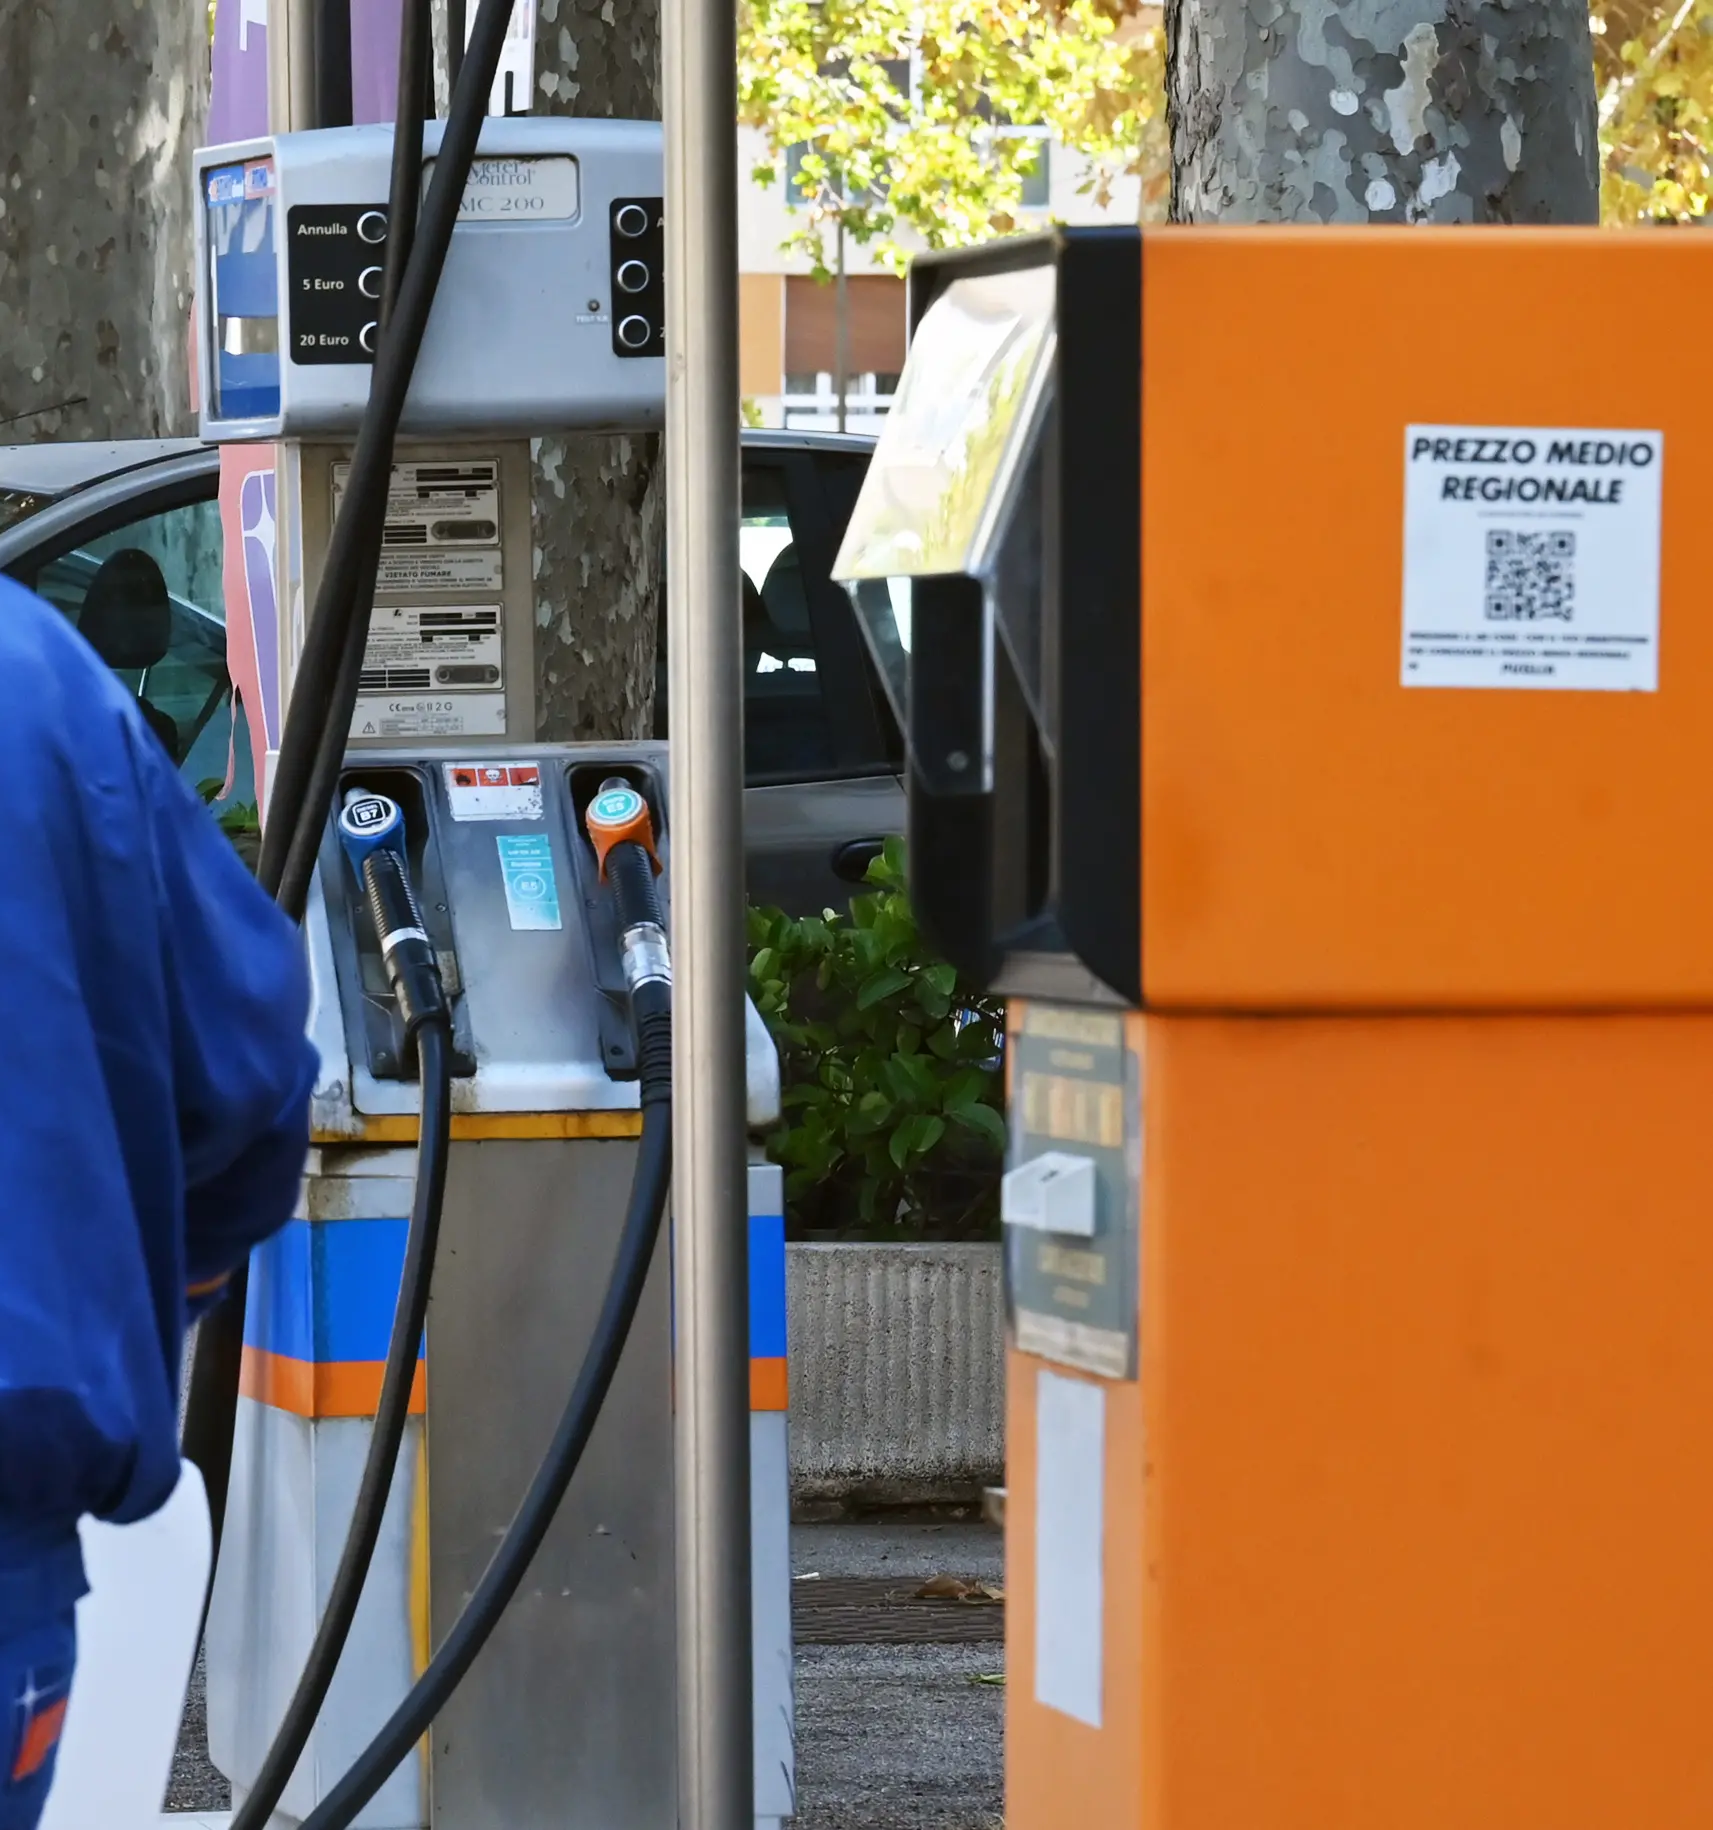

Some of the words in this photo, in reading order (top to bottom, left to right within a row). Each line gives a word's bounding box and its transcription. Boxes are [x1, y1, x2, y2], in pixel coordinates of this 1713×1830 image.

[500, 196, 545, 211] 200
[297, 223, 348, 235] Annulla
[303, 279, 311, 290] 5
[314, 279, 344, 290] Euro
[300, 334, 316, 346] 20
[319, 334, 349, 346] Euro
[1412, 437, 1537, 464] PREZZO
[1545, 440, 1654, 467] MEDIO
[1441, 476, 1624, 503] REGIONALE
